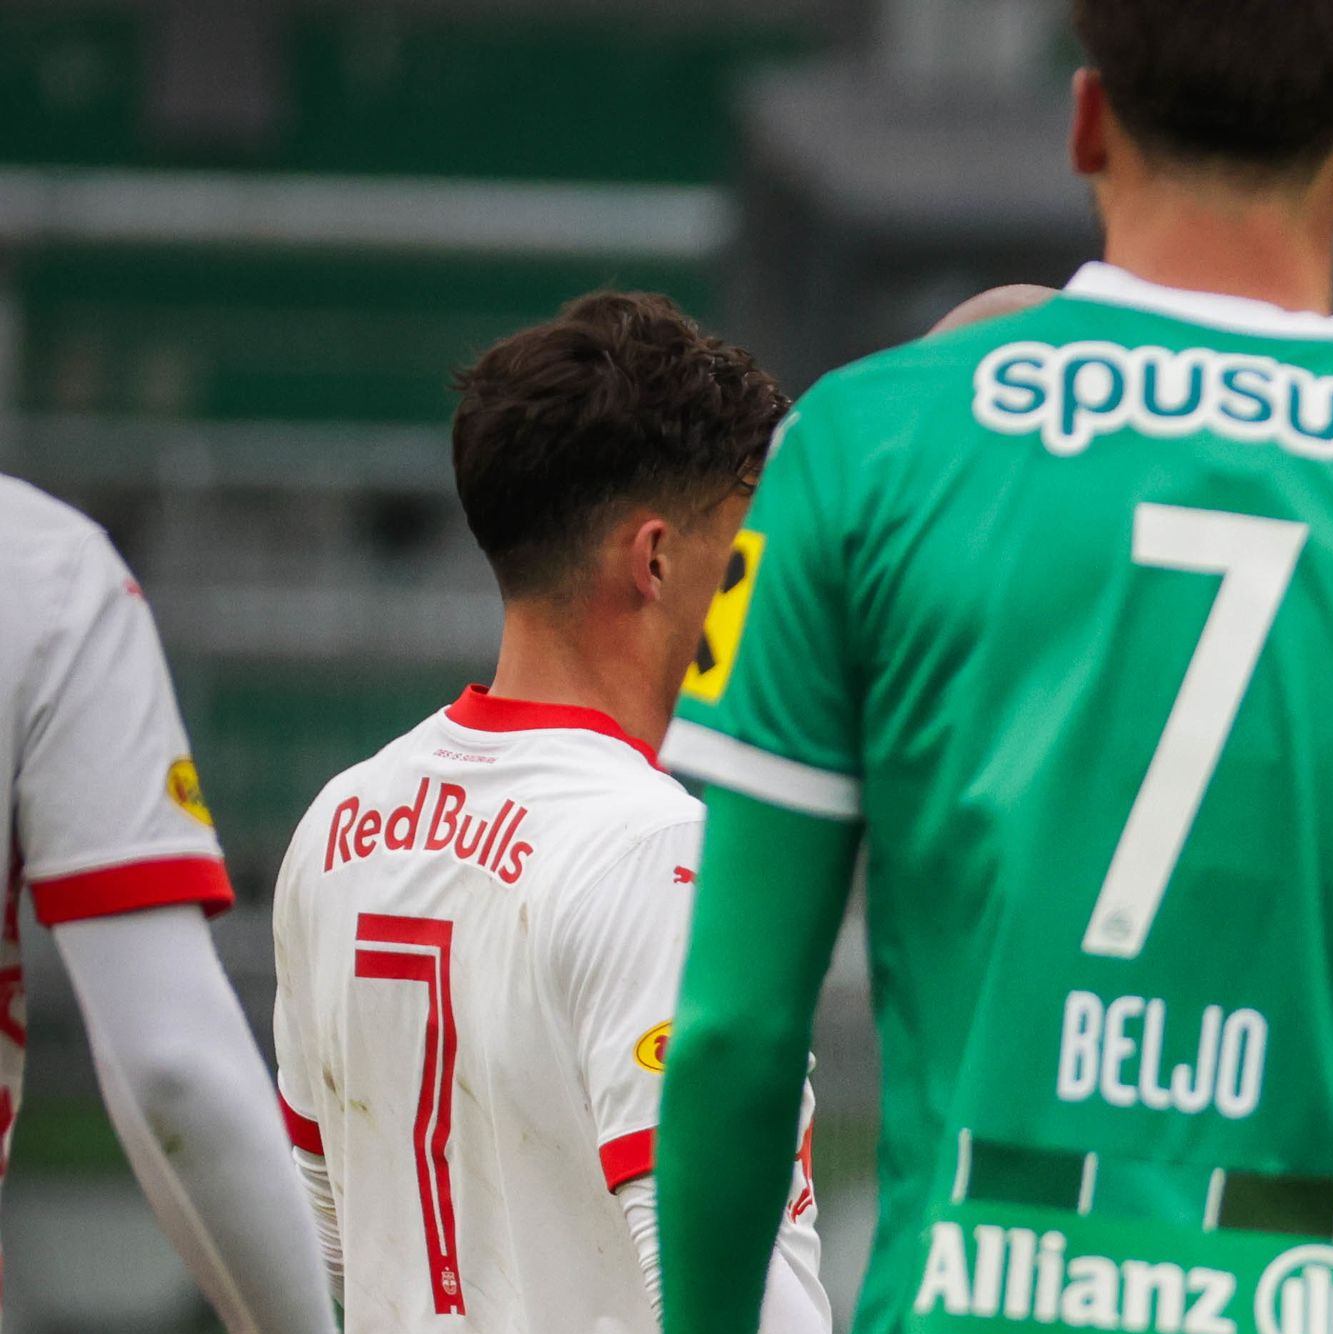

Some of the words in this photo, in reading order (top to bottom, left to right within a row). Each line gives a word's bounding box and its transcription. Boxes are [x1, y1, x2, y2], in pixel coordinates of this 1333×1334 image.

[323, 776, 431, 873] Red
[423, 782, 535, 885] Bulls
[1081, 502, 1310, 958] 7
[354, 912, 467, 1316] 7
[1056, 989, 1269, 1120] BELJO
